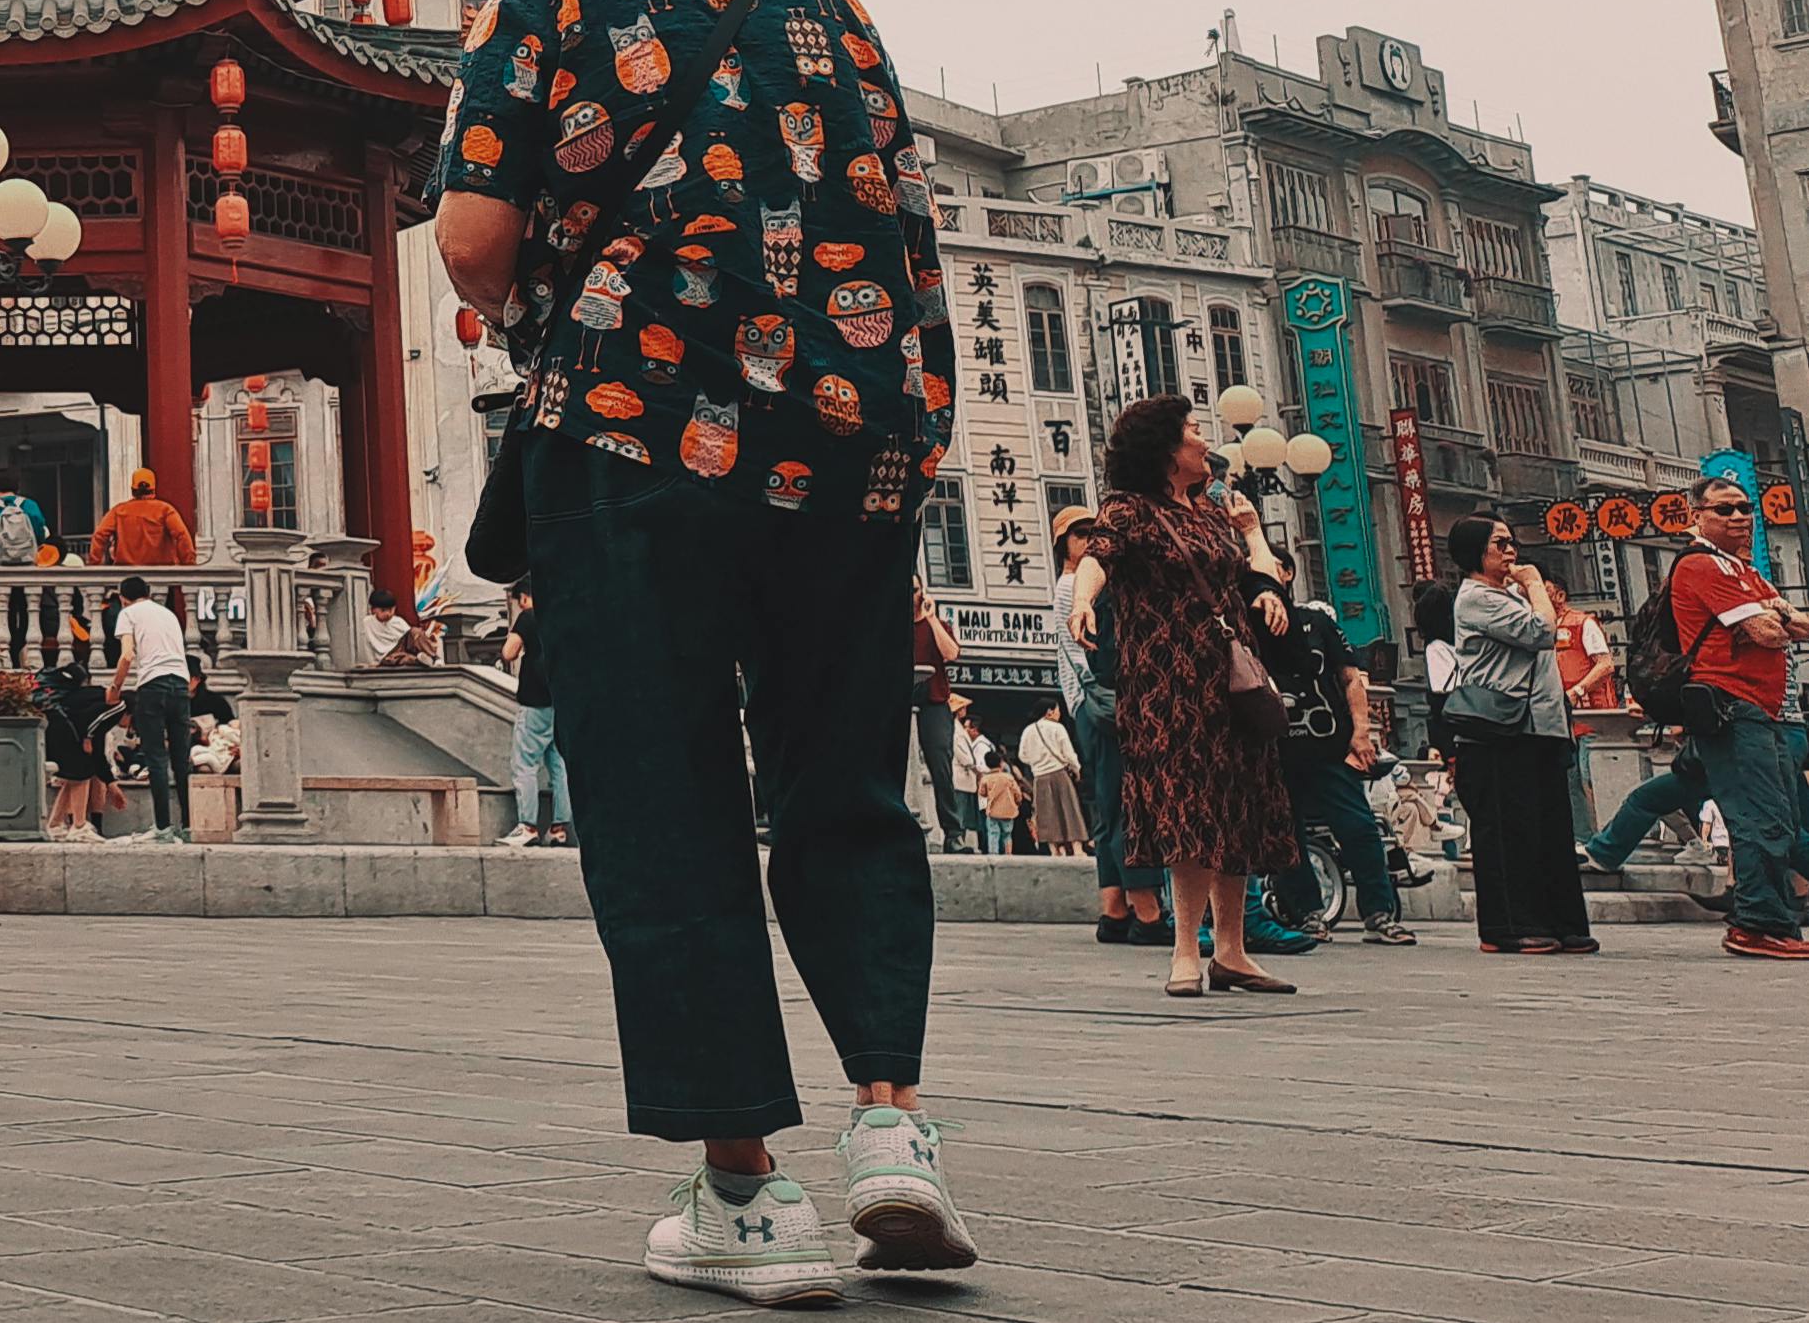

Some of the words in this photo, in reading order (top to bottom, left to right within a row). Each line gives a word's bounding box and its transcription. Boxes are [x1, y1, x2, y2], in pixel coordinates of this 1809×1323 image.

[1185, 327, 1210, 406] 中西
[967, 262, 1010, 405] 英美罐頭
[989, 443, 1031, 586] 南洋北貨
[1043, 420, 1074, 458] 百
[957, 610, 991, 629] MAU
[1002, 612, 1044, 631] SANG
[959, 628, 1019, 643] IMPORTERS
